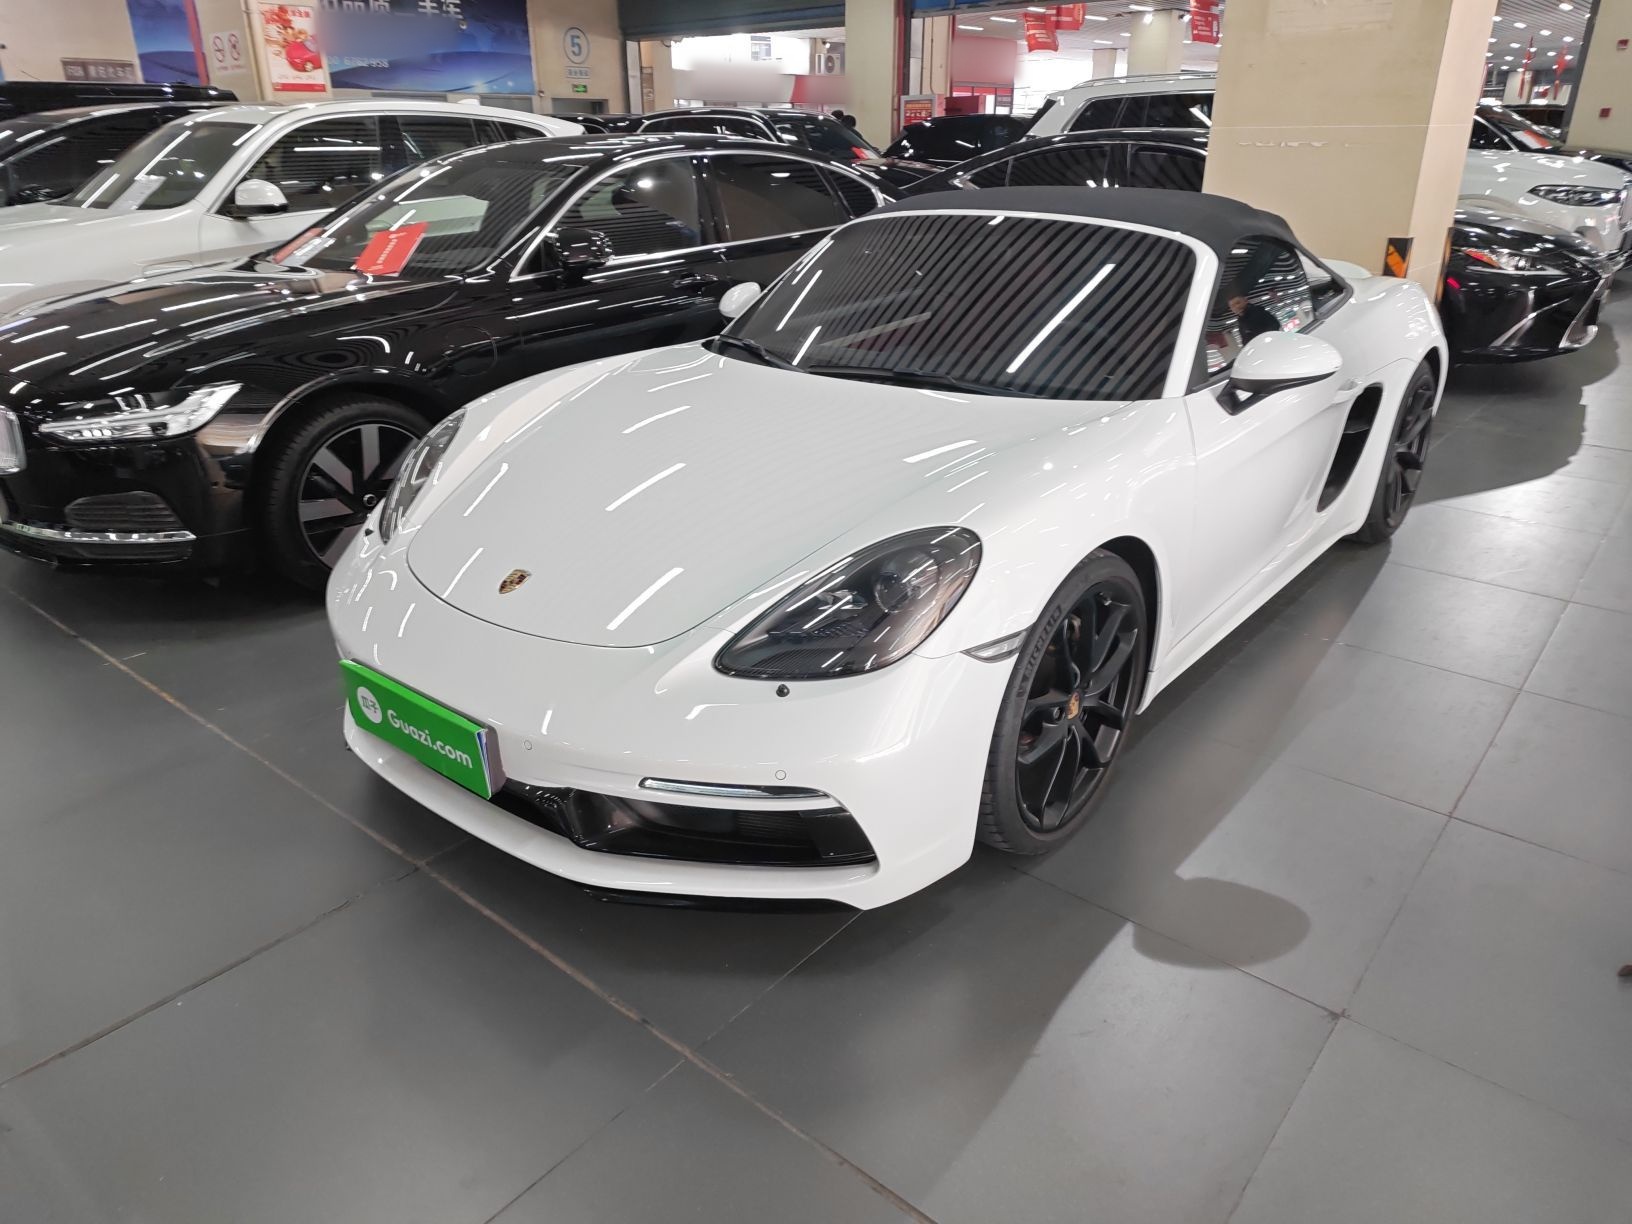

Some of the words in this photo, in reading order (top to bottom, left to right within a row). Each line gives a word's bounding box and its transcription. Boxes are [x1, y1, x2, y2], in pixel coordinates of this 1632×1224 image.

[569, 34, 582, 57] 5
[360, 695, 379, 714] 瓜子
[386, 709, 473, 769] Guazi.com
